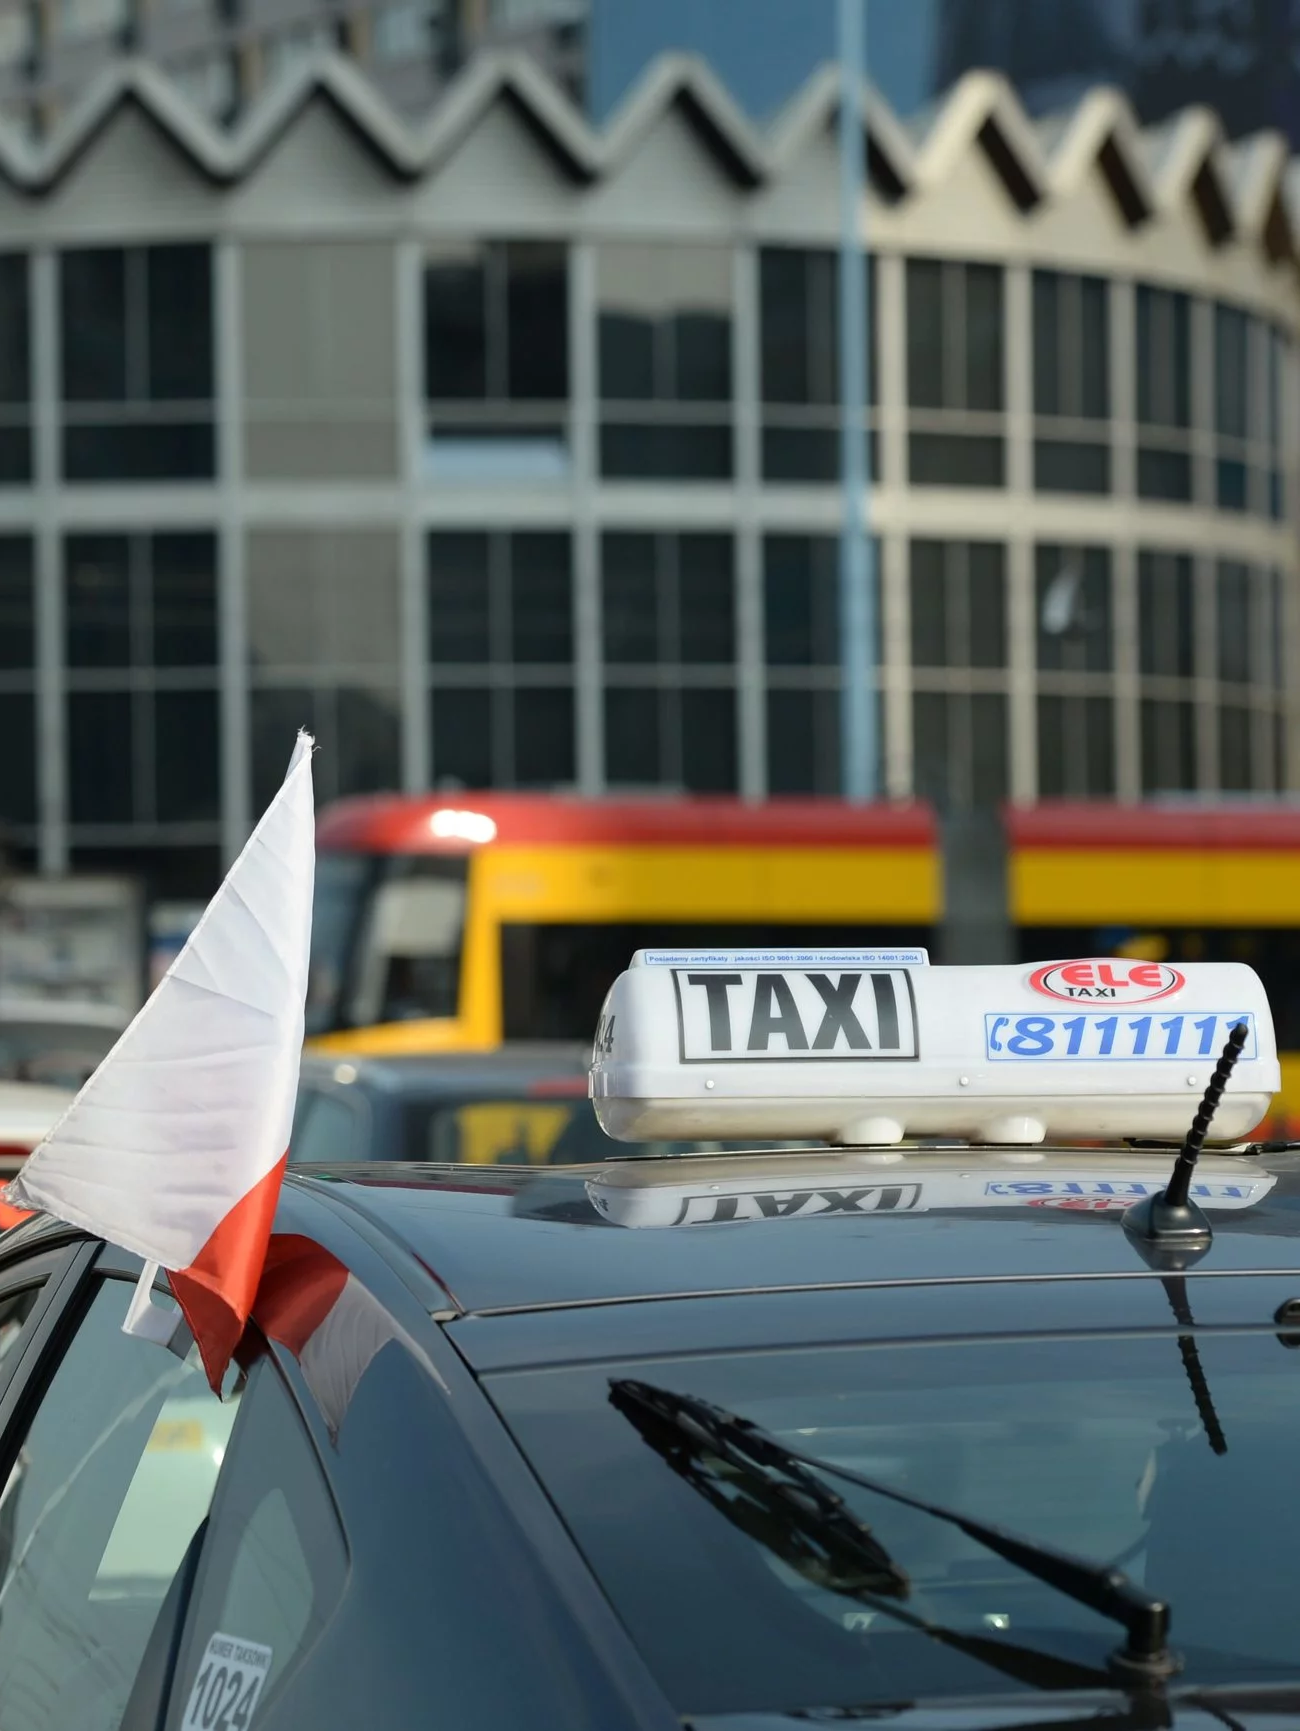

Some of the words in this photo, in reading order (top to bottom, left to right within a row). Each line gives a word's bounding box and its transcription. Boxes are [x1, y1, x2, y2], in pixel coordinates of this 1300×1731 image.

[1061, 964, 1162, 987] ELE
[1065, 988, 1116, 998] TAXI
[687, 974, 900, 1051] TAXI
[190, 1662, 260, 1731] 1024
